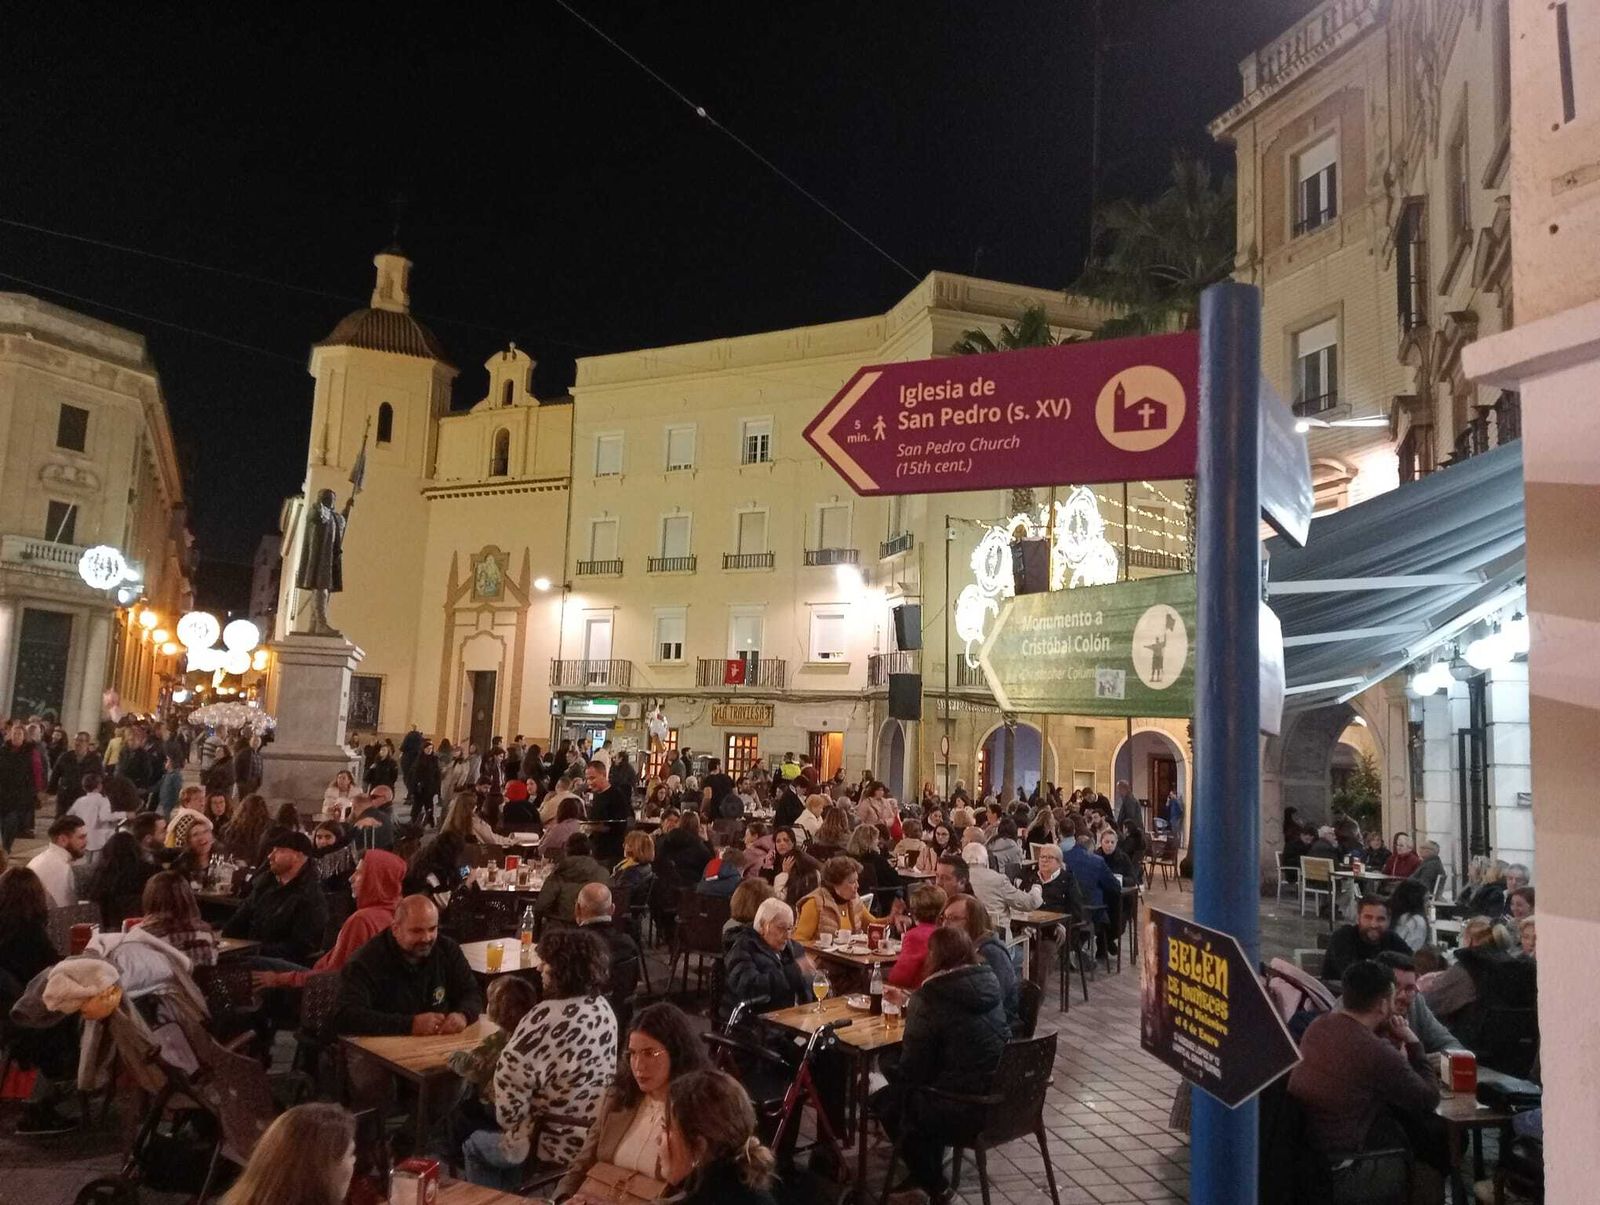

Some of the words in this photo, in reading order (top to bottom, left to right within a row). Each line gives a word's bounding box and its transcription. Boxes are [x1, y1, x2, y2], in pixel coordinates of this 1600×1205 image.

[900, 379, 964, 408] Iglesia
[969, 377, 996, 397] de
[854, 420, 861, 430] 5
[898, 410, 935, 430] San
[941, 403, 1001, 427] Pedro
[1006, 402, 1030, 424] (s.
[1035, 398, 1071, 420] XV)
[847, 432, 871, 443] min.
[896, 443, 922, 457] San
[925, 440, 966, 455] Pedro
[969, 434, 1020, 452] Church
[896, 460, 931, 478] (15th
[934, 458, 973, 474] cent.)
[1022, 610, 1092, 632] Monumento
[1095, 610, 1103, 625] a
[1022, 635, 1072, 657] Cristóbal
[1074, 632, 1111, 653] Colón
[1167, 936, 1229, 1000] BELÉN
